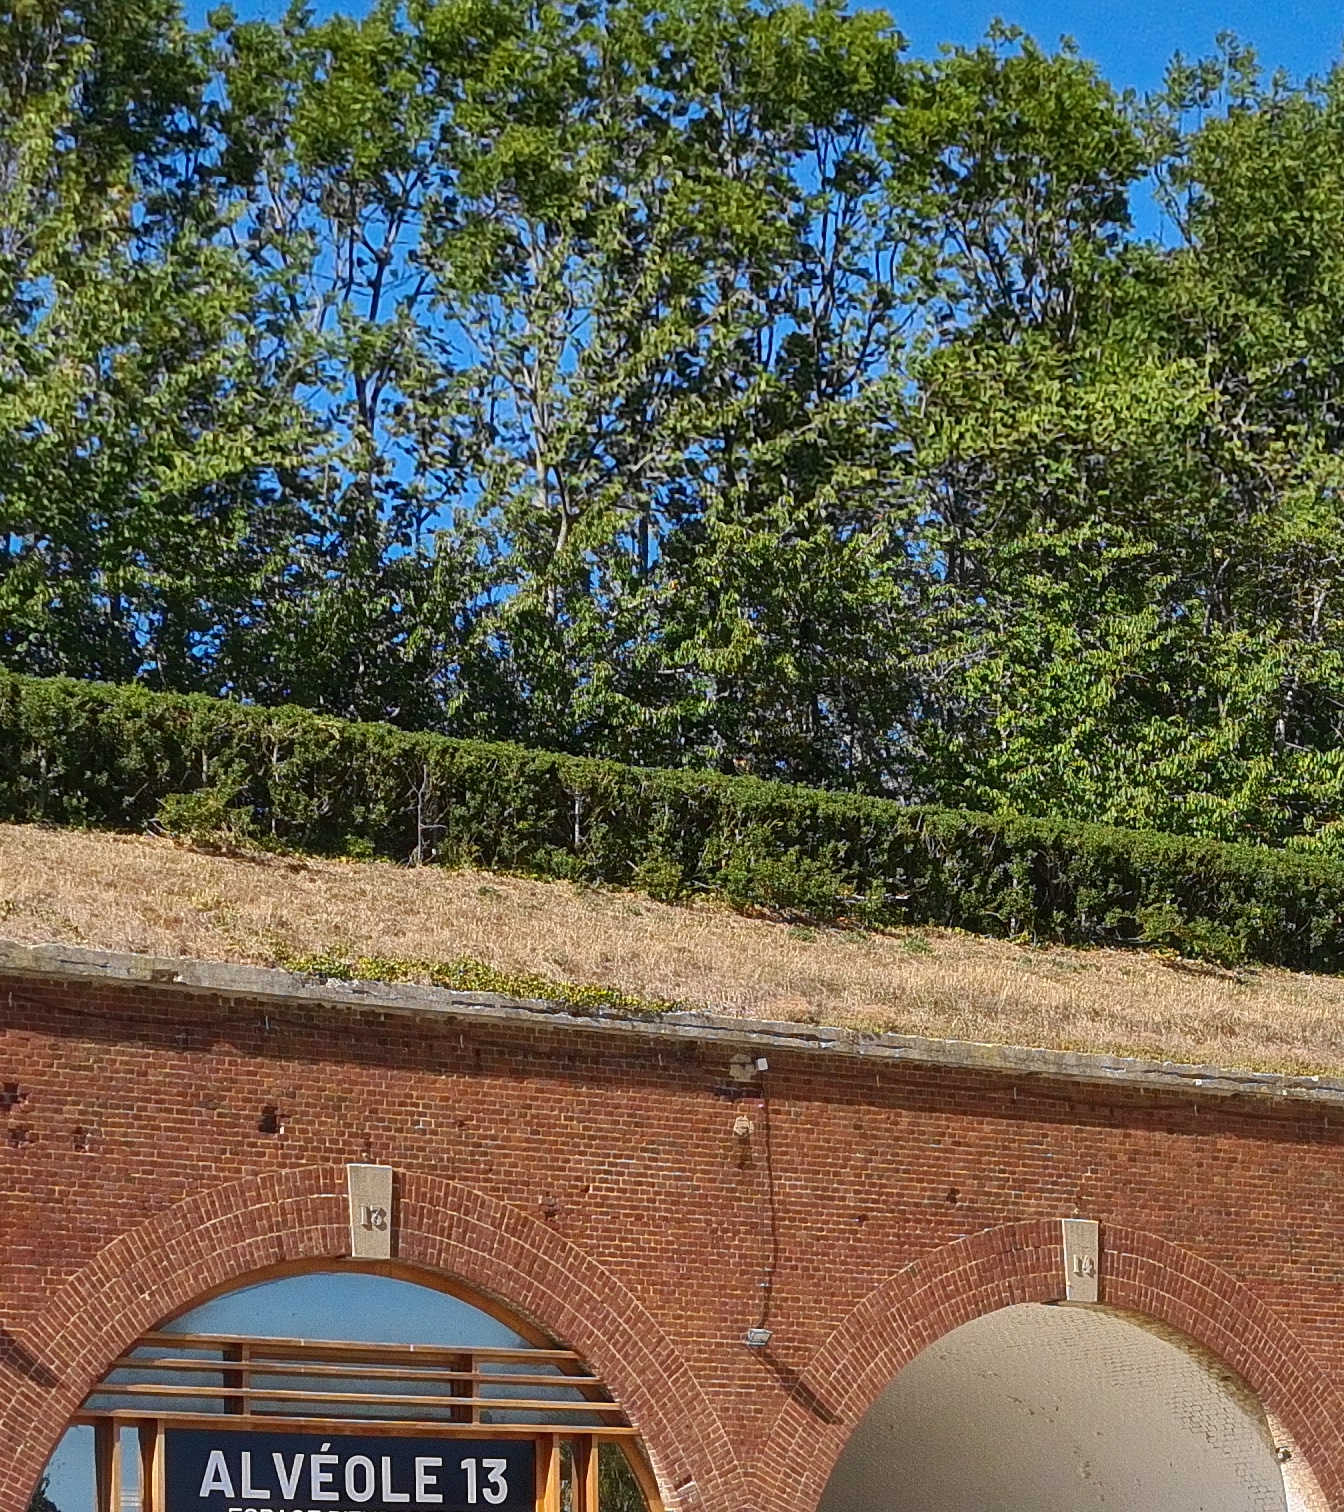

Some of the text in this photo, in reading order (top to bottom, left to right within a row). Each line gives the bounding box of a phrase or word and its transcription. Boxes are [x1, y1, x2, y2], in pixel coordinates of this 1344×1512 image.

[359, 1203, 384, 1228] 13
[1072, 1253, 1094, 1275] 14
[198, 1442, 509, 1505] ALVÉOLE 13
